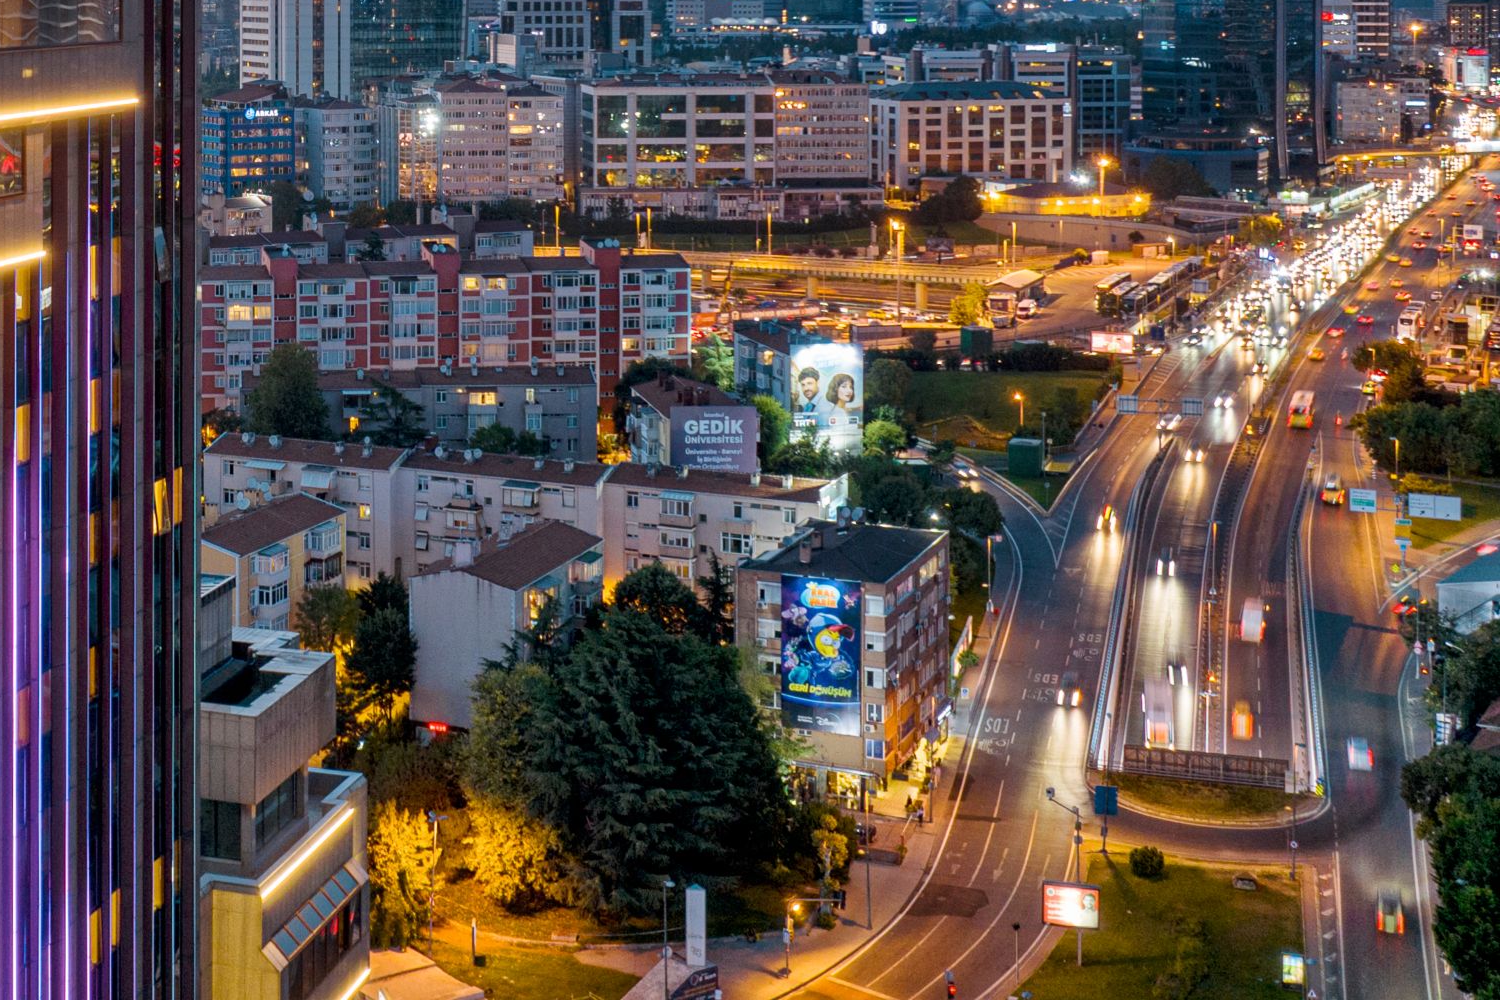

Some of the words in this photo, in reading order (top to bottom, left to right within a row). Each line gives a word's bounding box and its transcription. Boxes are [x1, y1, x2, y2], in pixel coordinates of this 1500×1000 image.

[255, 109, 279, 117] ARKAS
[684, 416, 744, 434] GEDİK
[685, 435, 743, 444] ÜNİVERSİTESİ
